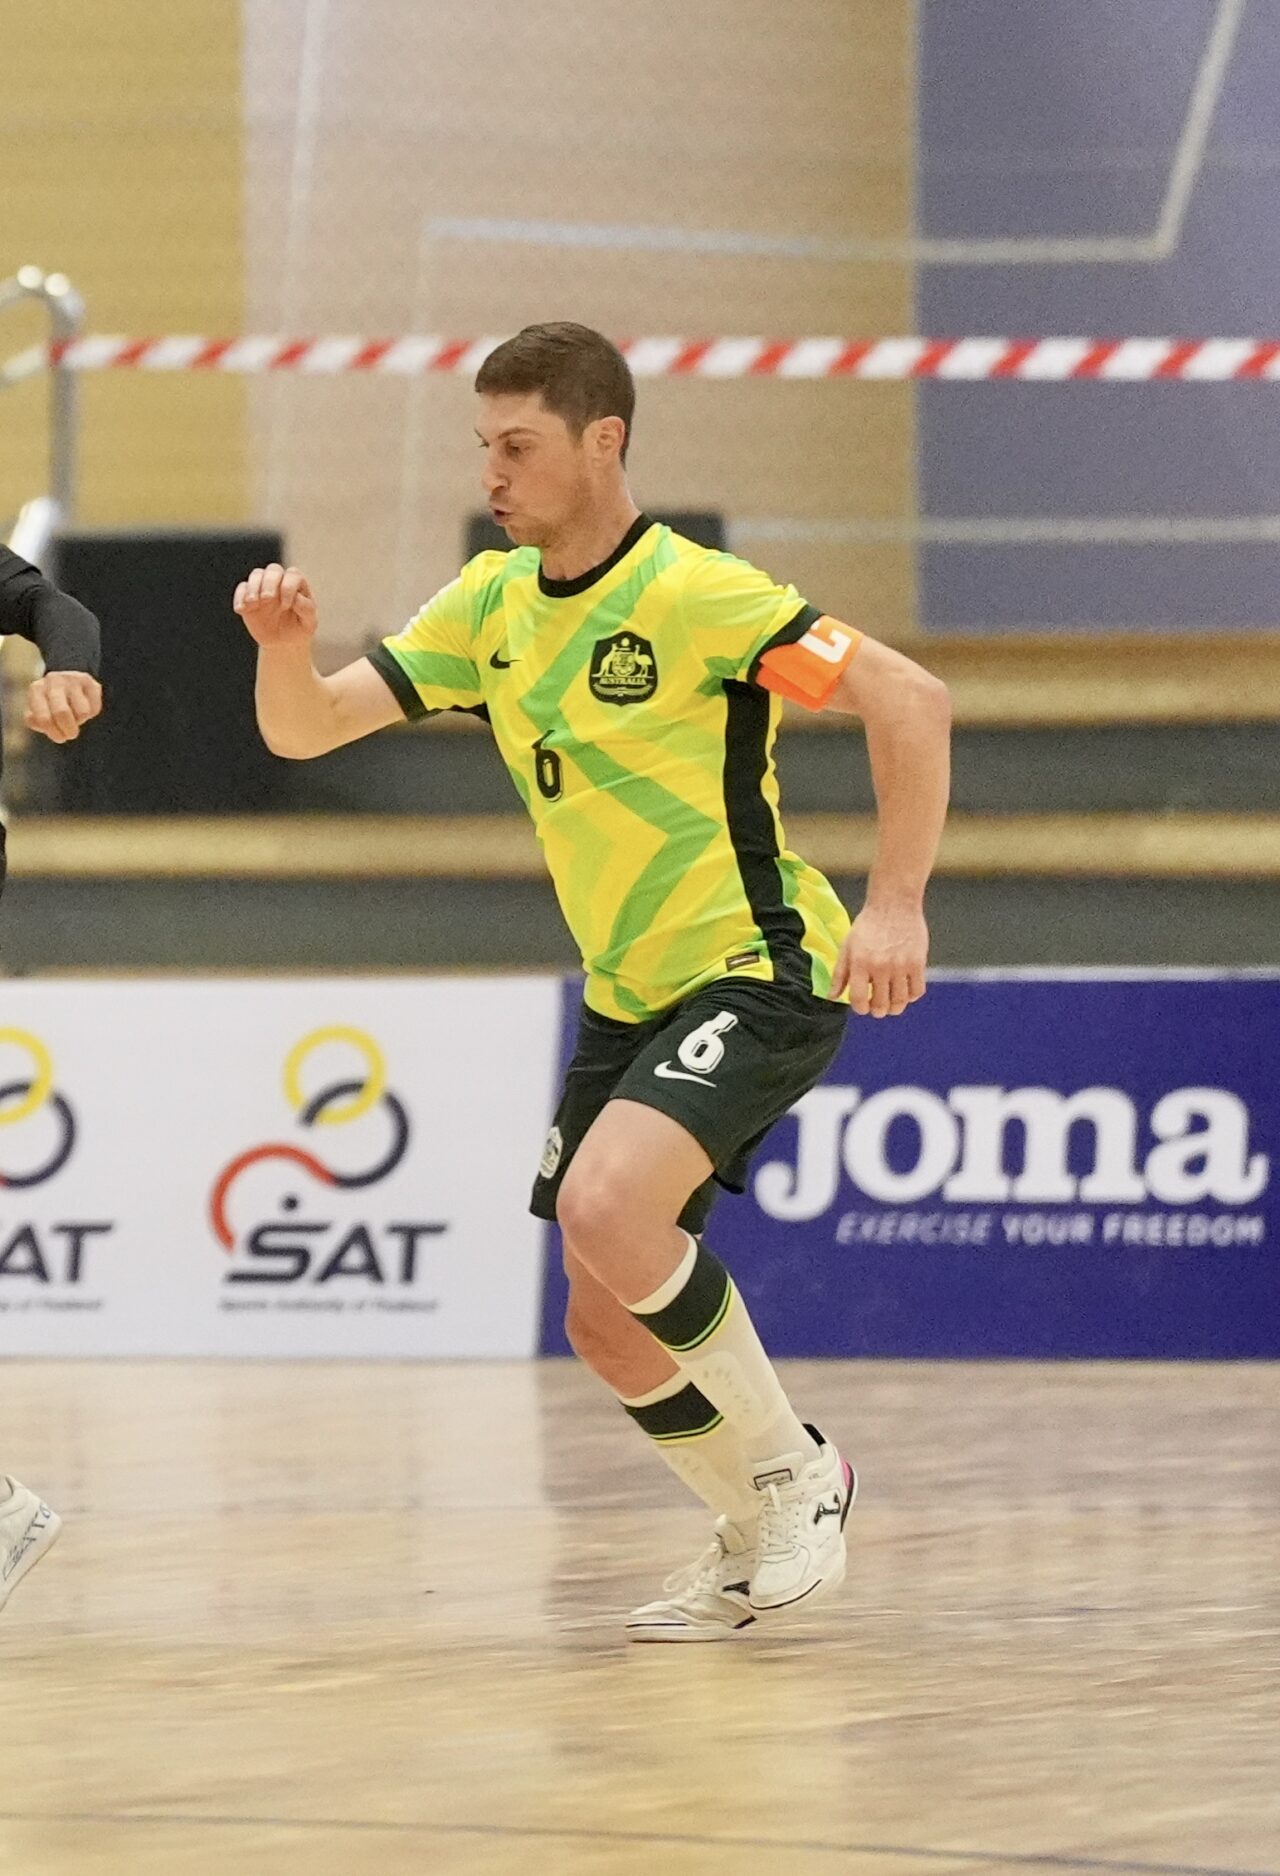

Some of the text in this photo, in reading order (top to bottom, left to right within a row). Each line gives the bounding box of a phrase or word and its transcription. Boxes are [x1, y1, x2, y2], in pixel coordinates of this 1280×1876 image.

[531, 730, 564, 803] 6
[677, 1010, 739, 1074] 6
[224, 1222, 448, 1285] SAT
[835, 1212, 1266, 1246] EXERCISE YOUR FREEDOM
